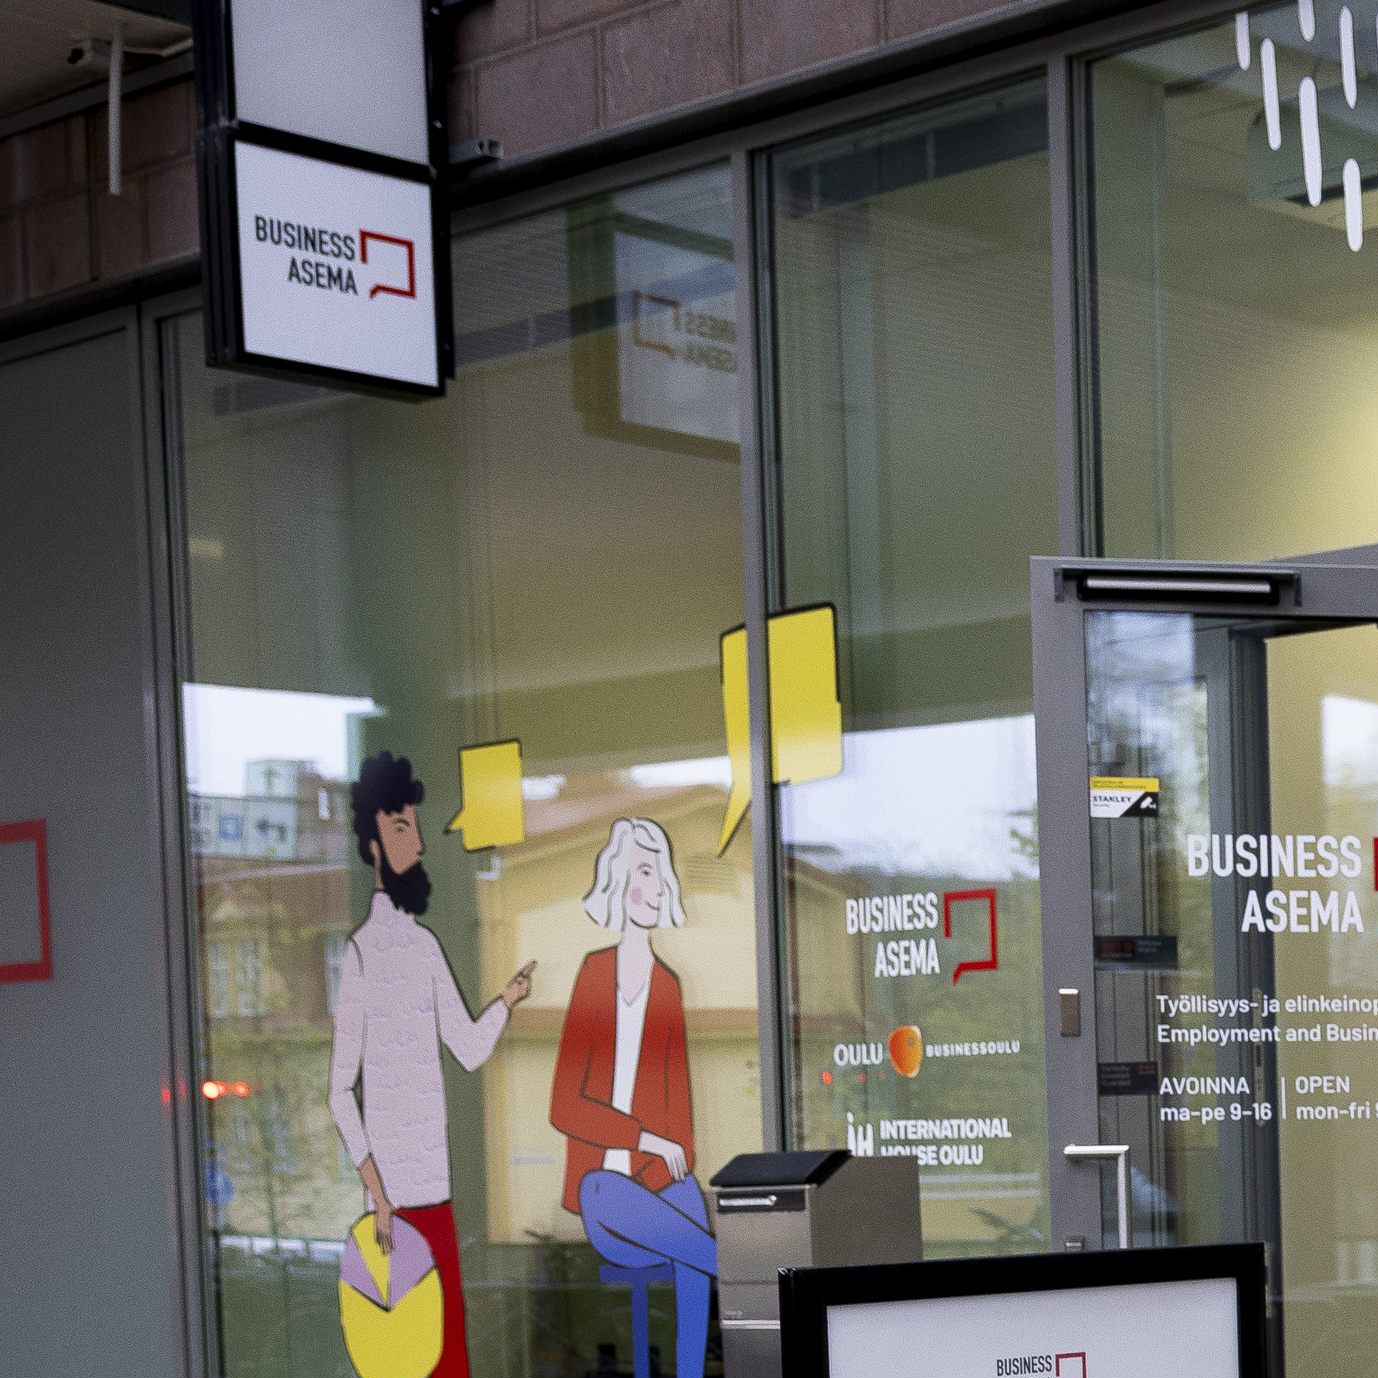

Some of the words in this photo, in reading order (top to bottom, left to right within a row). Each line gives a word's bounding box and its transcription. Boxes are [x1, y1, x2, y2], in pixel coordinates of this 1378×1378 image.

[254, 214, 357, 263] BUSINESS
[287, 256, 358, 296] ASEMA
[1093, 795, 1132, 803] STANLEY
[1187, 833, 1363, 878] BUSINESS
[845, 892, 939, 936] BUSINESS
[1241, 889, 1365, 934] ASEMA
[874, 937, 941, 979] ASEMA
[1156, 994, 1259, 1018] Työllisyys-
[1261, 994, 1281, 1018] ja
[1157, 1024, 1281, 1047] Employment
[1285, 1023, 1321, 1043] and
[833, 1041, 884, 1067] OULU
[925, 1039, 1021, 1059] BUSINESSOULU
[1159, 1076, 1251, 1096] AVOINNA
[1295, 1075, 1351, 1095] OPEN
[879, 1117, 1013, 1141] INTERNATIONAL
[939, 1144, 984, 1166] OULU
[996, 1354, 1053, 1377] BUSINESS
